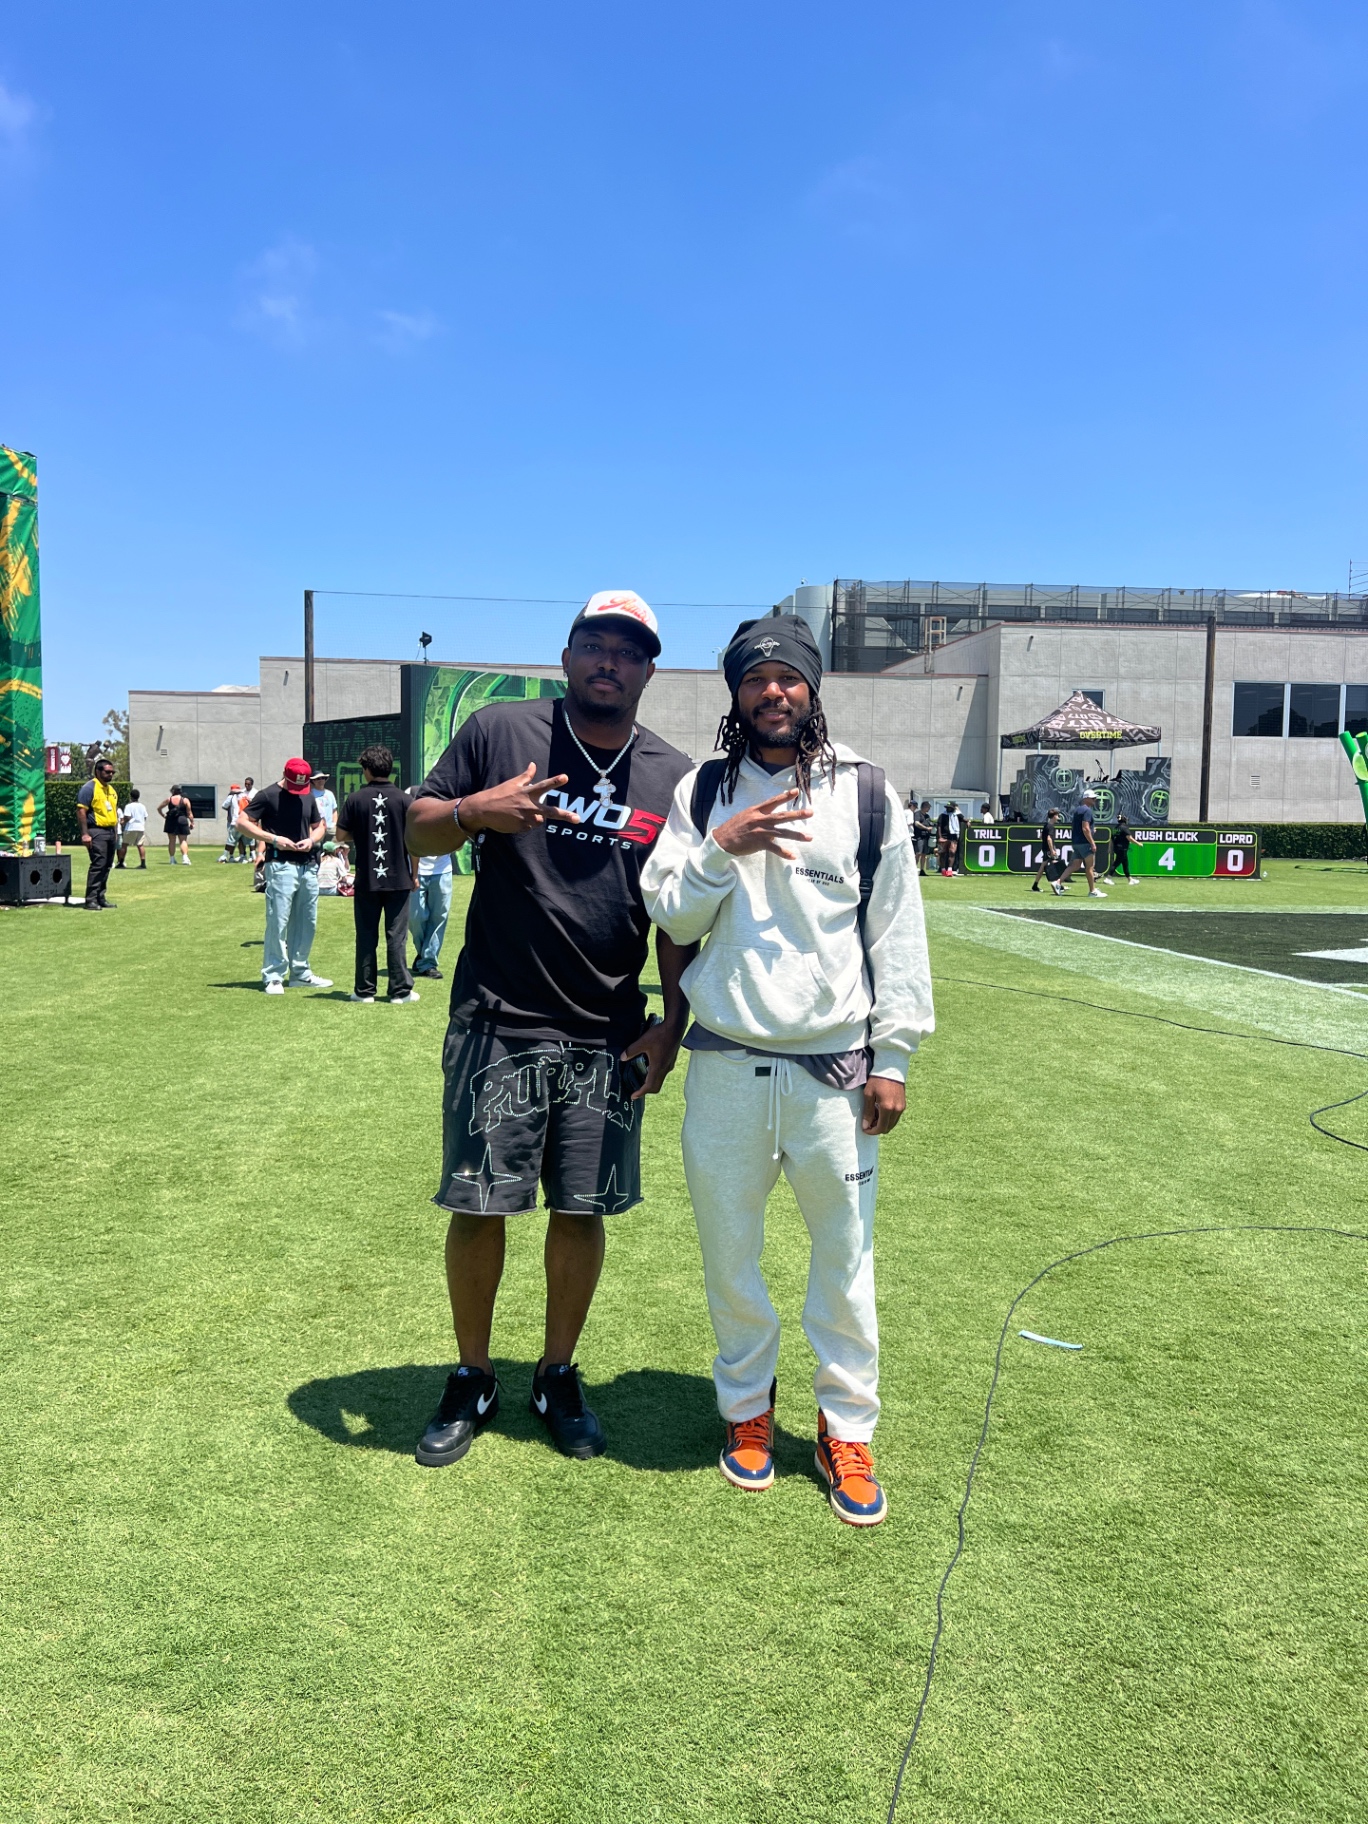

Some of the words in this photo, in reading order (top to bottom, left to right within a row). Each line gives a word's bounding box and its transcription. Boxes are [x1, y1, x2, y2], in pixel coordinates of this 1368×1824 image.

[1079, 731, 1122, 739] OVERTIME
[546, 825, 632, 850] SPORTS
[973, 829, 1002, 839] TRILL
[1135, 831, 1161, 841] RUSH
[1165, 831, 1199, 842] CLOCK
[1219, 834, 1253, 844] LOPRO
[978, 845, 996, 867] 0
[1158, 847, 1176, 871] 4
[1227, 850, 1244, 872] 0
[795, 866, 845, 884] ESSENTIALS
